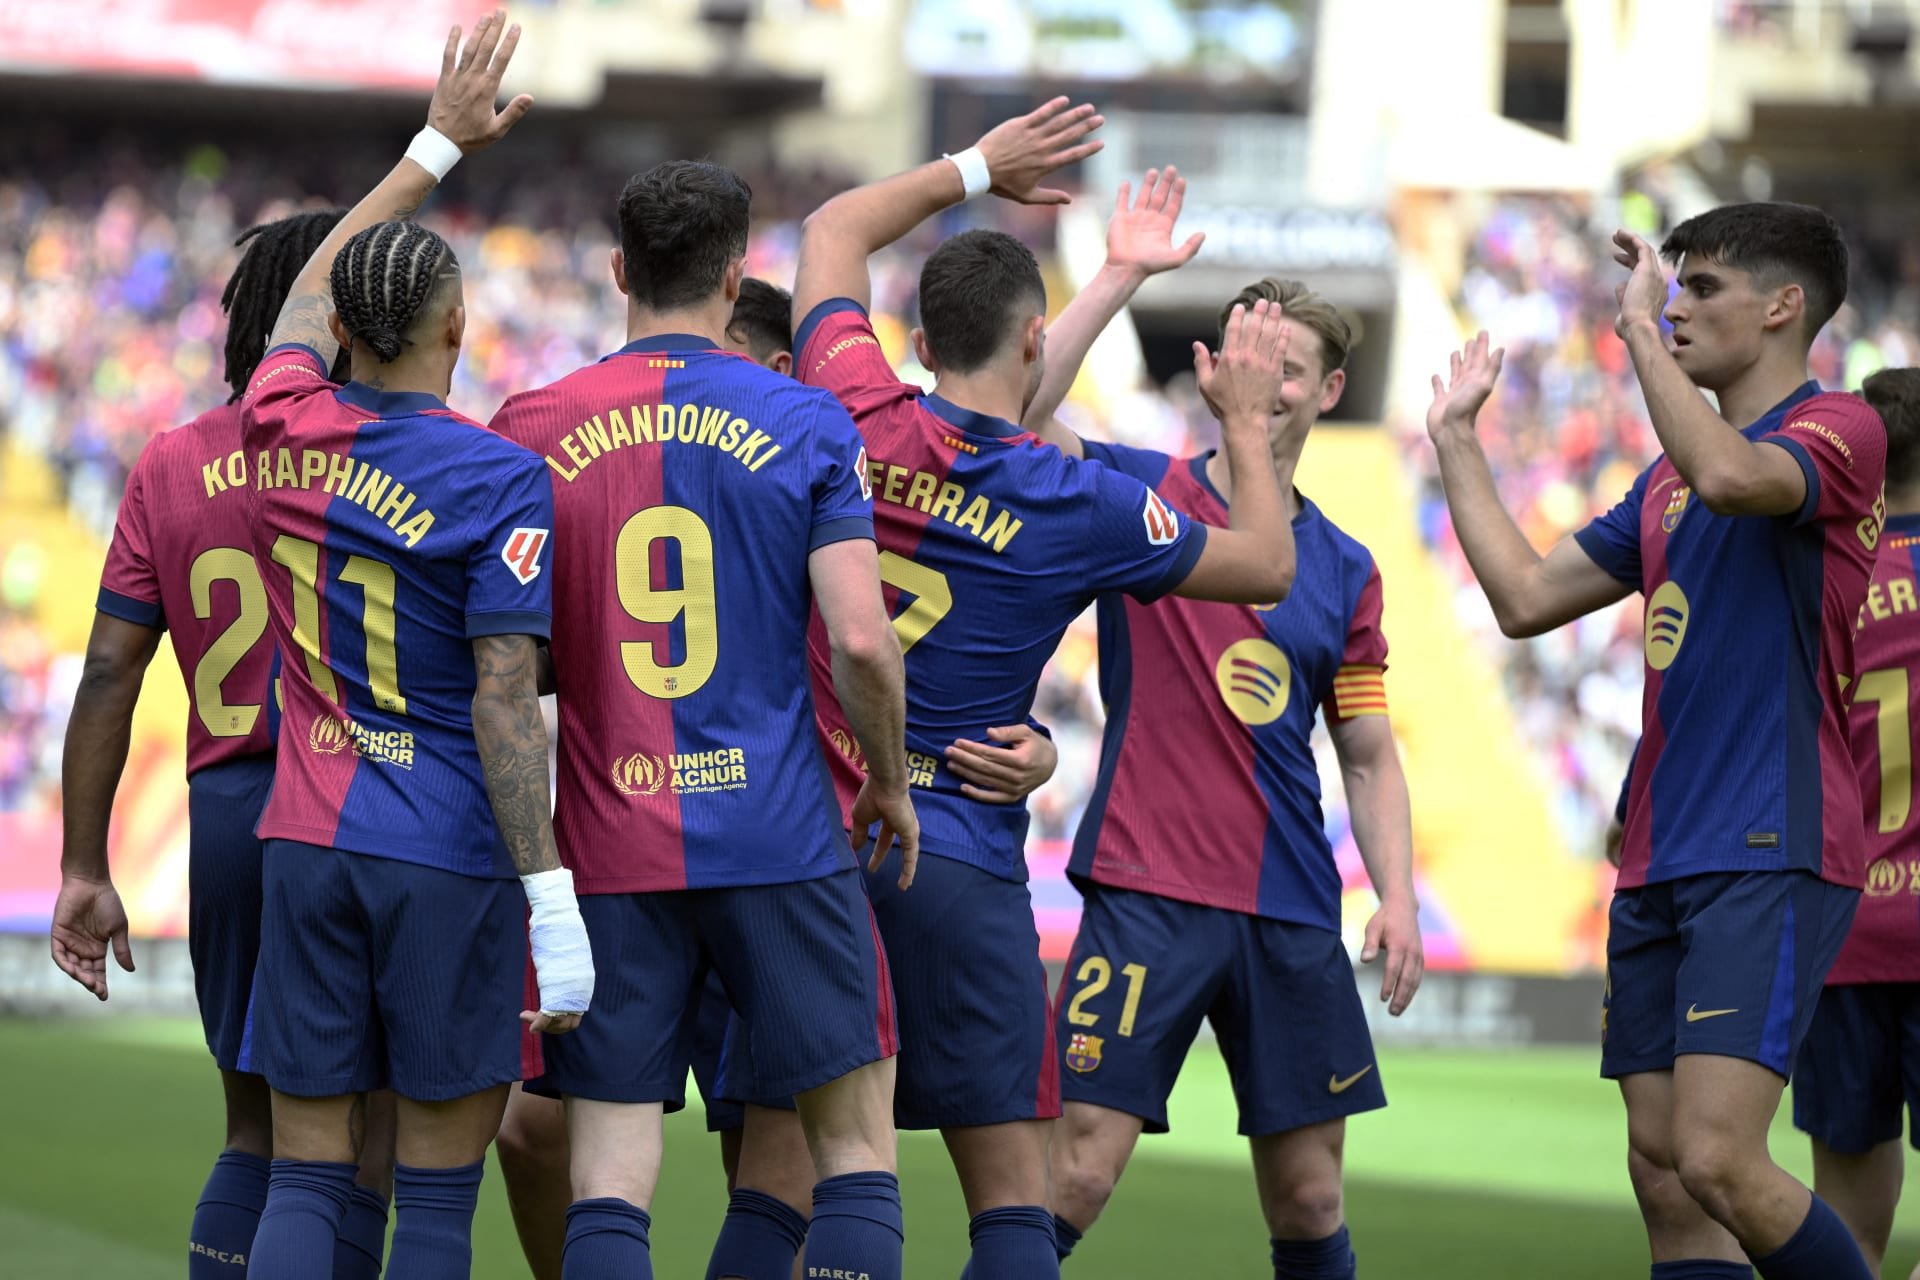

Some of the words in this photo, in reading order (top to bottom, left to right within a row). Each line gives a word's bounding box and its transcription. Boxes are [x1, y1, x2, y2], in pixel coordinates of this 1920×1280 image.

[544, 403, 782, 483] LEWANDOWSKI
[257, 447, 436, 548] RAPHINHA
[867, 460, 1023, 553] FERRAN
[1856, 480, 1886, 551] GE
[190, 547, 284, 737] 2
[271, 534, 408, 716] 11
[615, 505, 719, 699] 9
[878, 549, 953, 656] 7
[343, 719, 414, 749] UNHCR
[668, 748, 745, 771] UNHCR
[669, 764, 747, 788] ACNUR
[695, 785, 723, 793] Refugee
[723, 782, 748, 791] Agency
[1068, 956, 1148, 1037] 21
